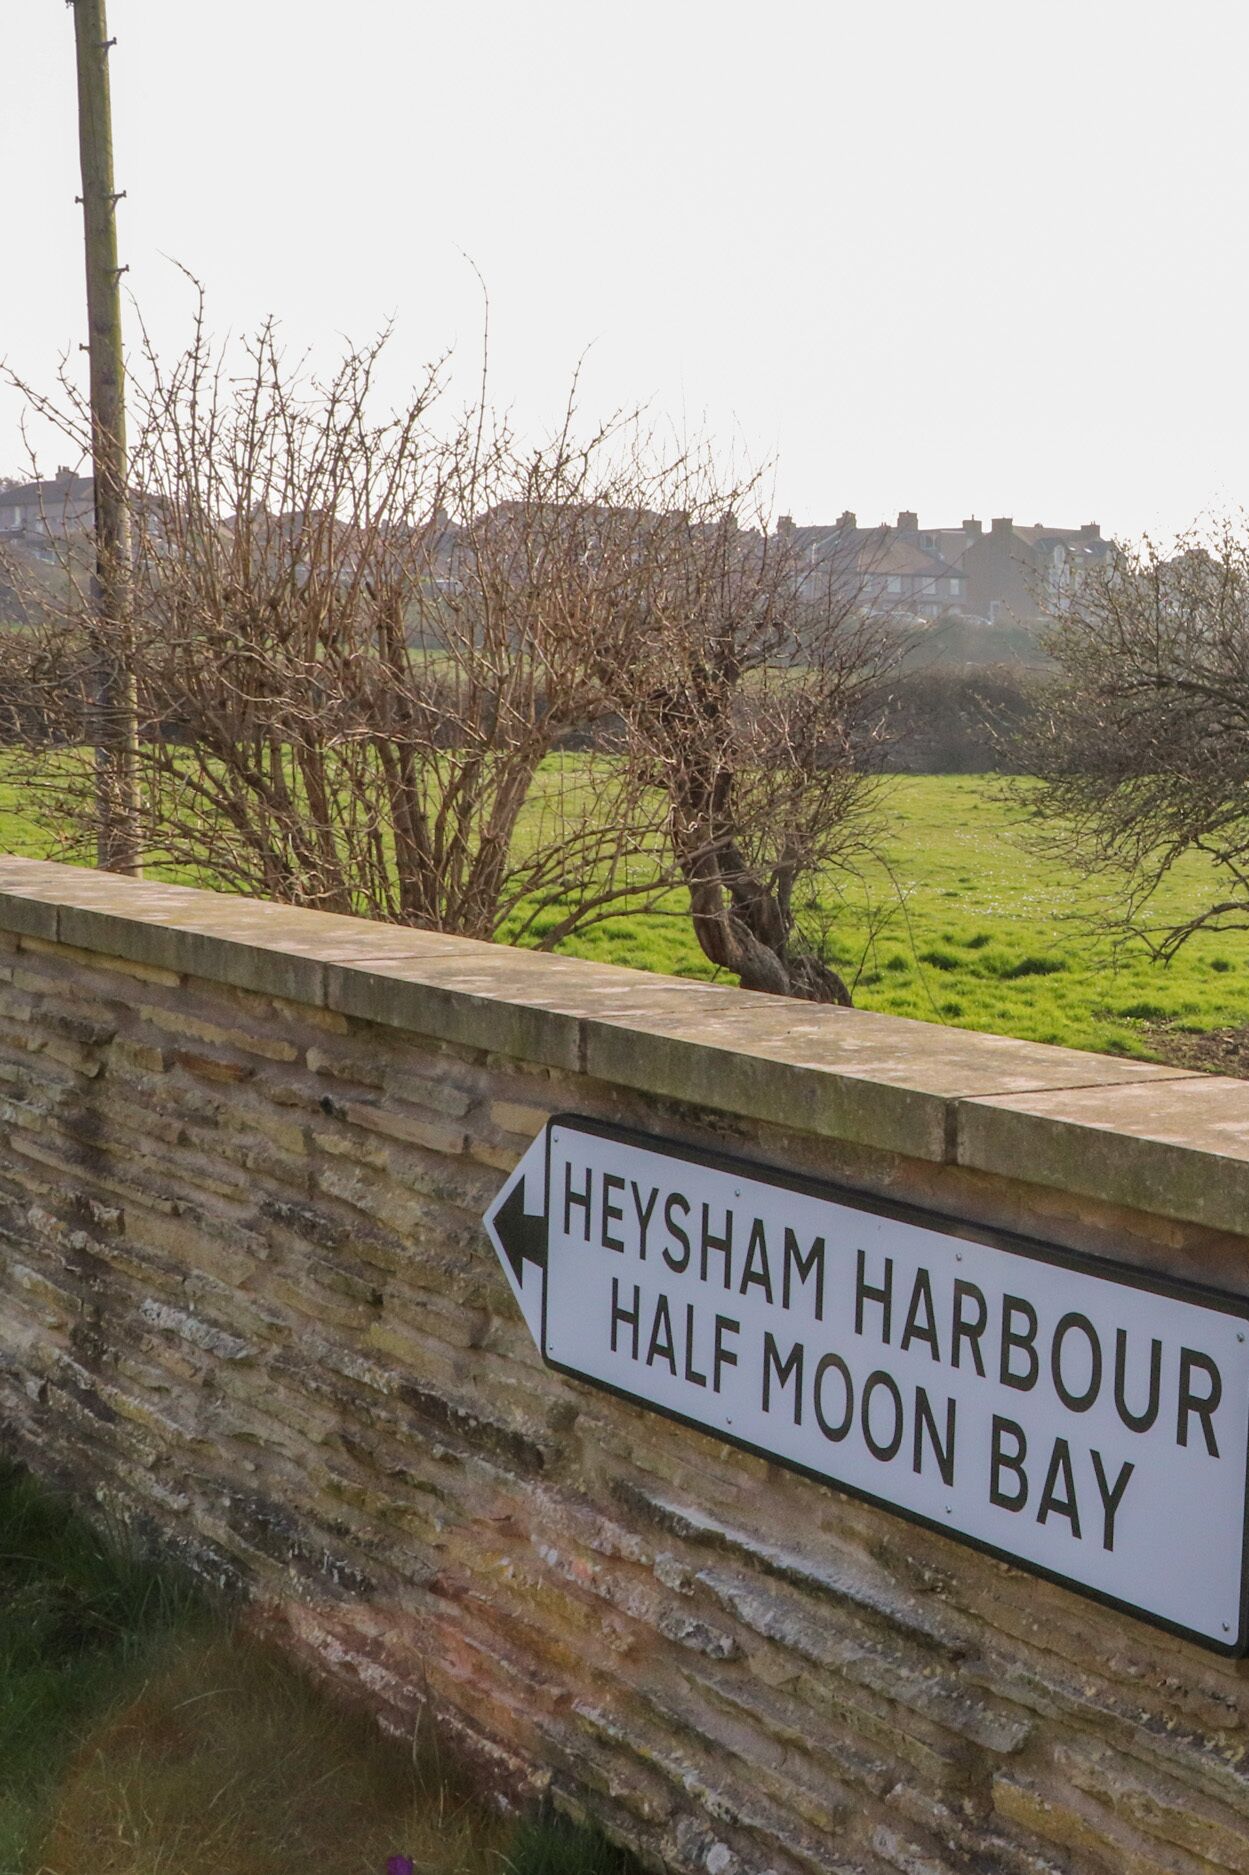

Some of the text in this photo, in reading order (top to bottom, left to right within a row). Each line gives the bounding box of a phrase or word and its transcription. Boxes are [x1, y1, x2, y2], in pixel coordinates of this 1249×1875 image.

[563, 1161, 1223, 1460] HEYSHAM HARBOUR
[610, 1276, 1136, 1553] HALF MOON BAY
